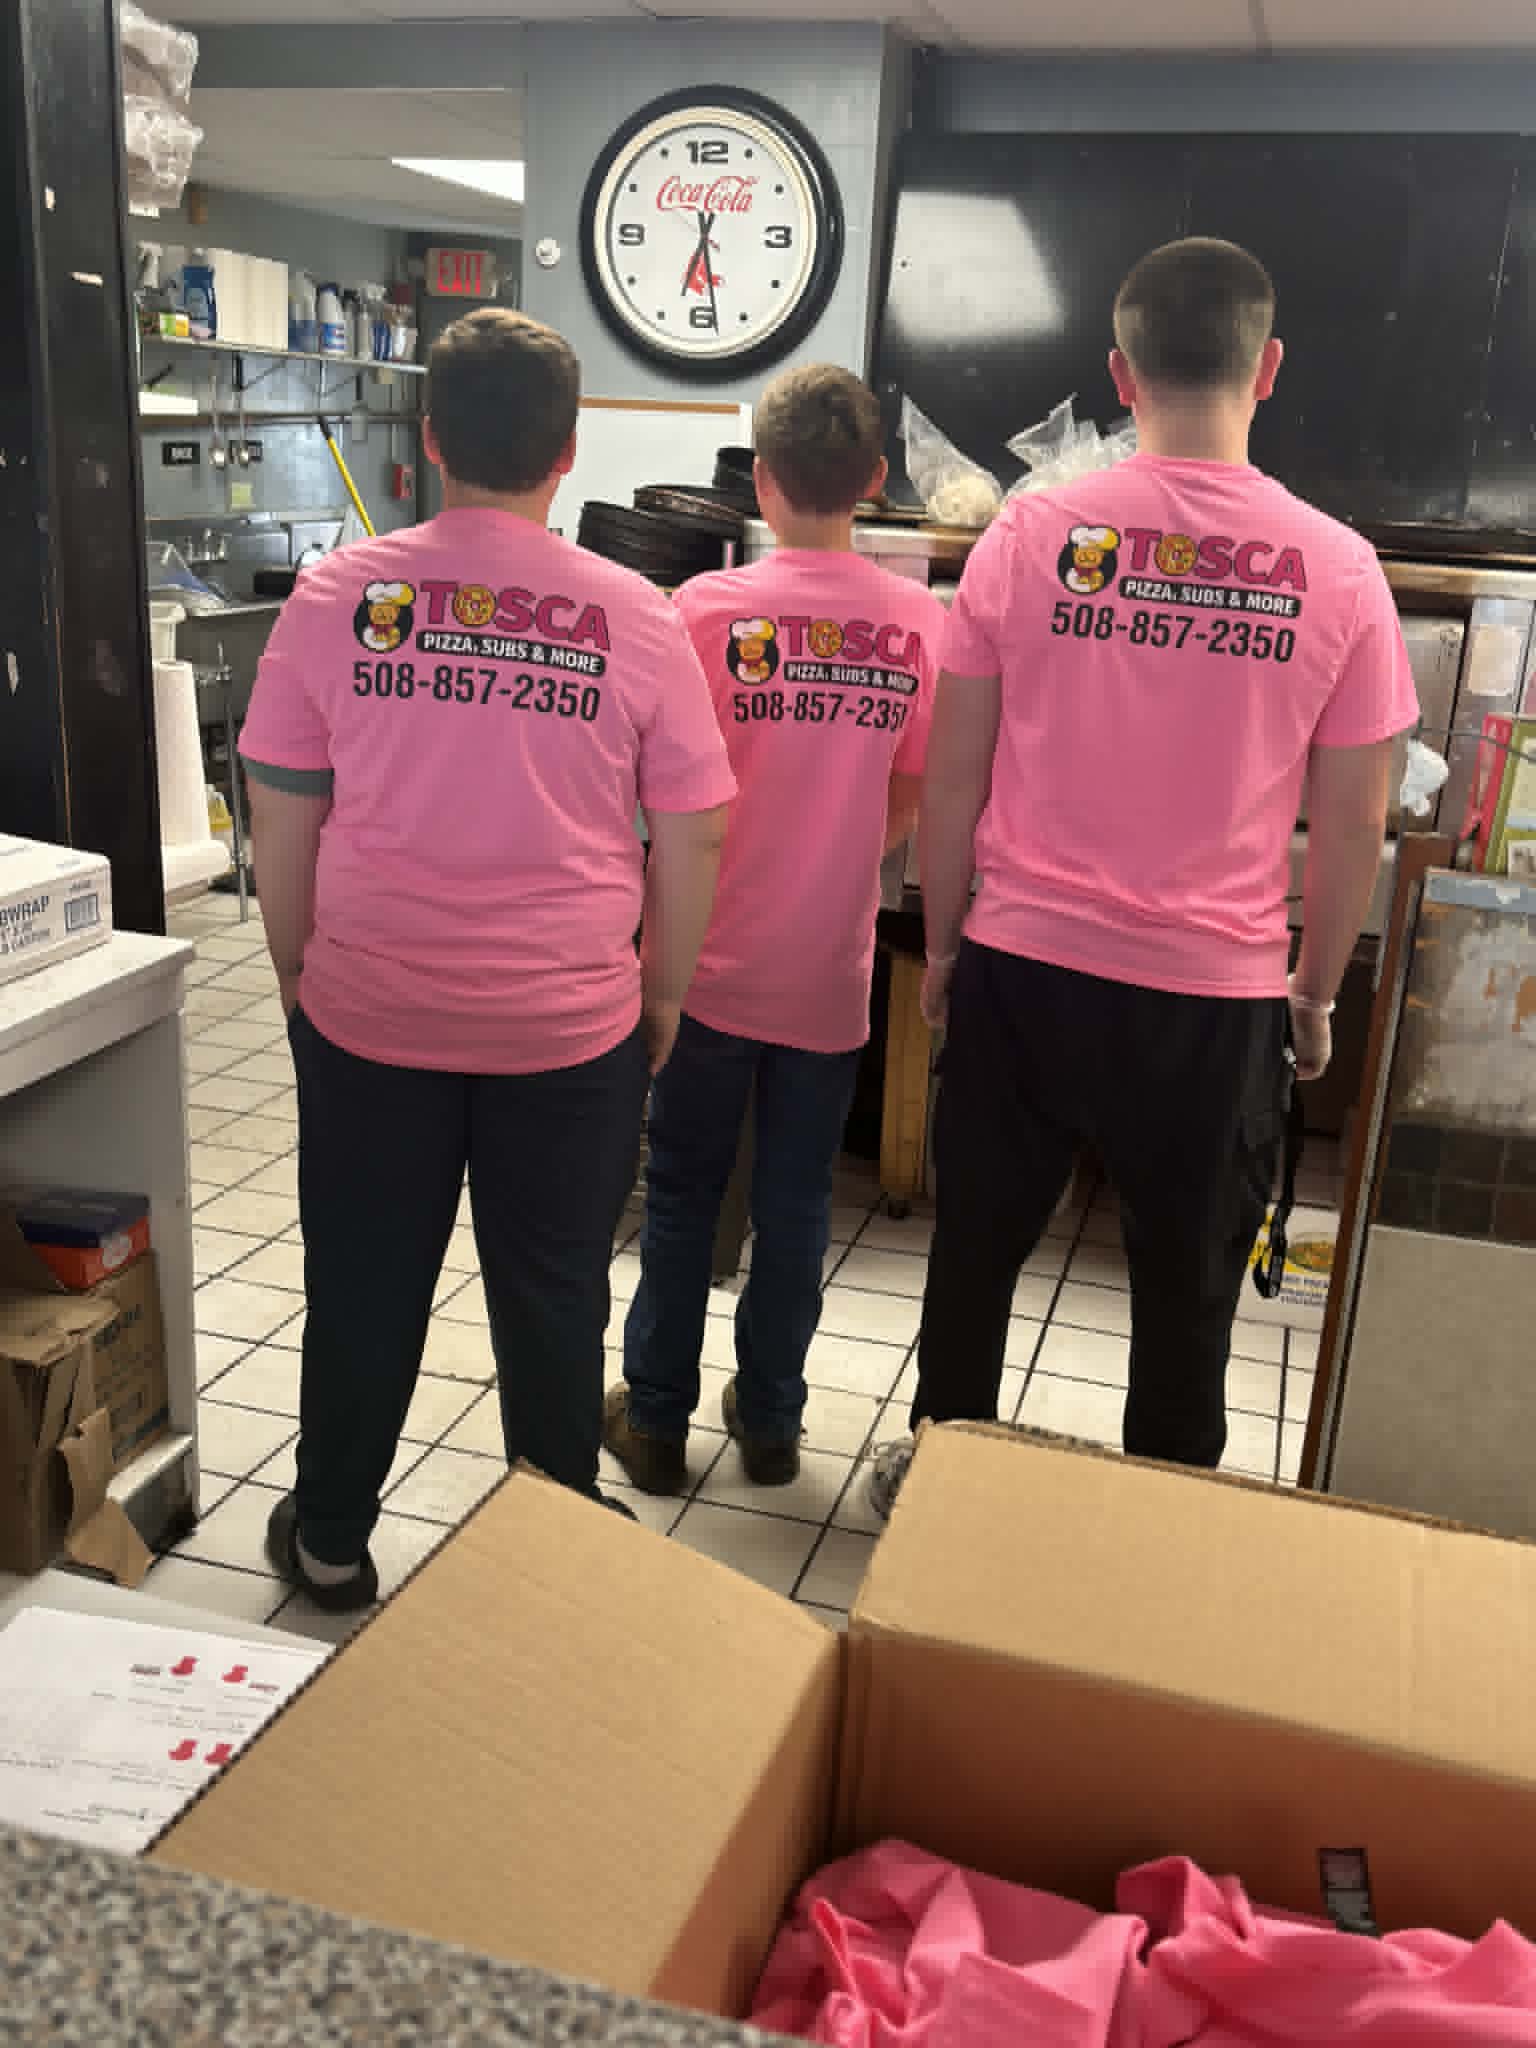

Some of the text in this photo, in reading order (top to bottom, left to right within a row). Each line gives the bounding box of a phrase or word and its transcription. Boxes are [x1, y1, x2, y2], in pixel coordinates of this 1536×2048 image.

[686, 141, 728, 163] 12
[619, 223, 644, 246] 9
[765, 225, 791, 248] 3
[437, 251, 486, 295] EXIT
[690, 306, 713, 328] 6
[1124, 527, 1307, 592] TOSCA
[419, 580, 611, 652] TOSCA
[1126, 581, 1295, 616] PIZZA, SUBS & MORE
[1050, 601, 1296, 662] 508-857-2350
[423, 632, 600, 673] PIZZA, SUBS & MORE
[353, 661, 601, 721] 508-857-2350
